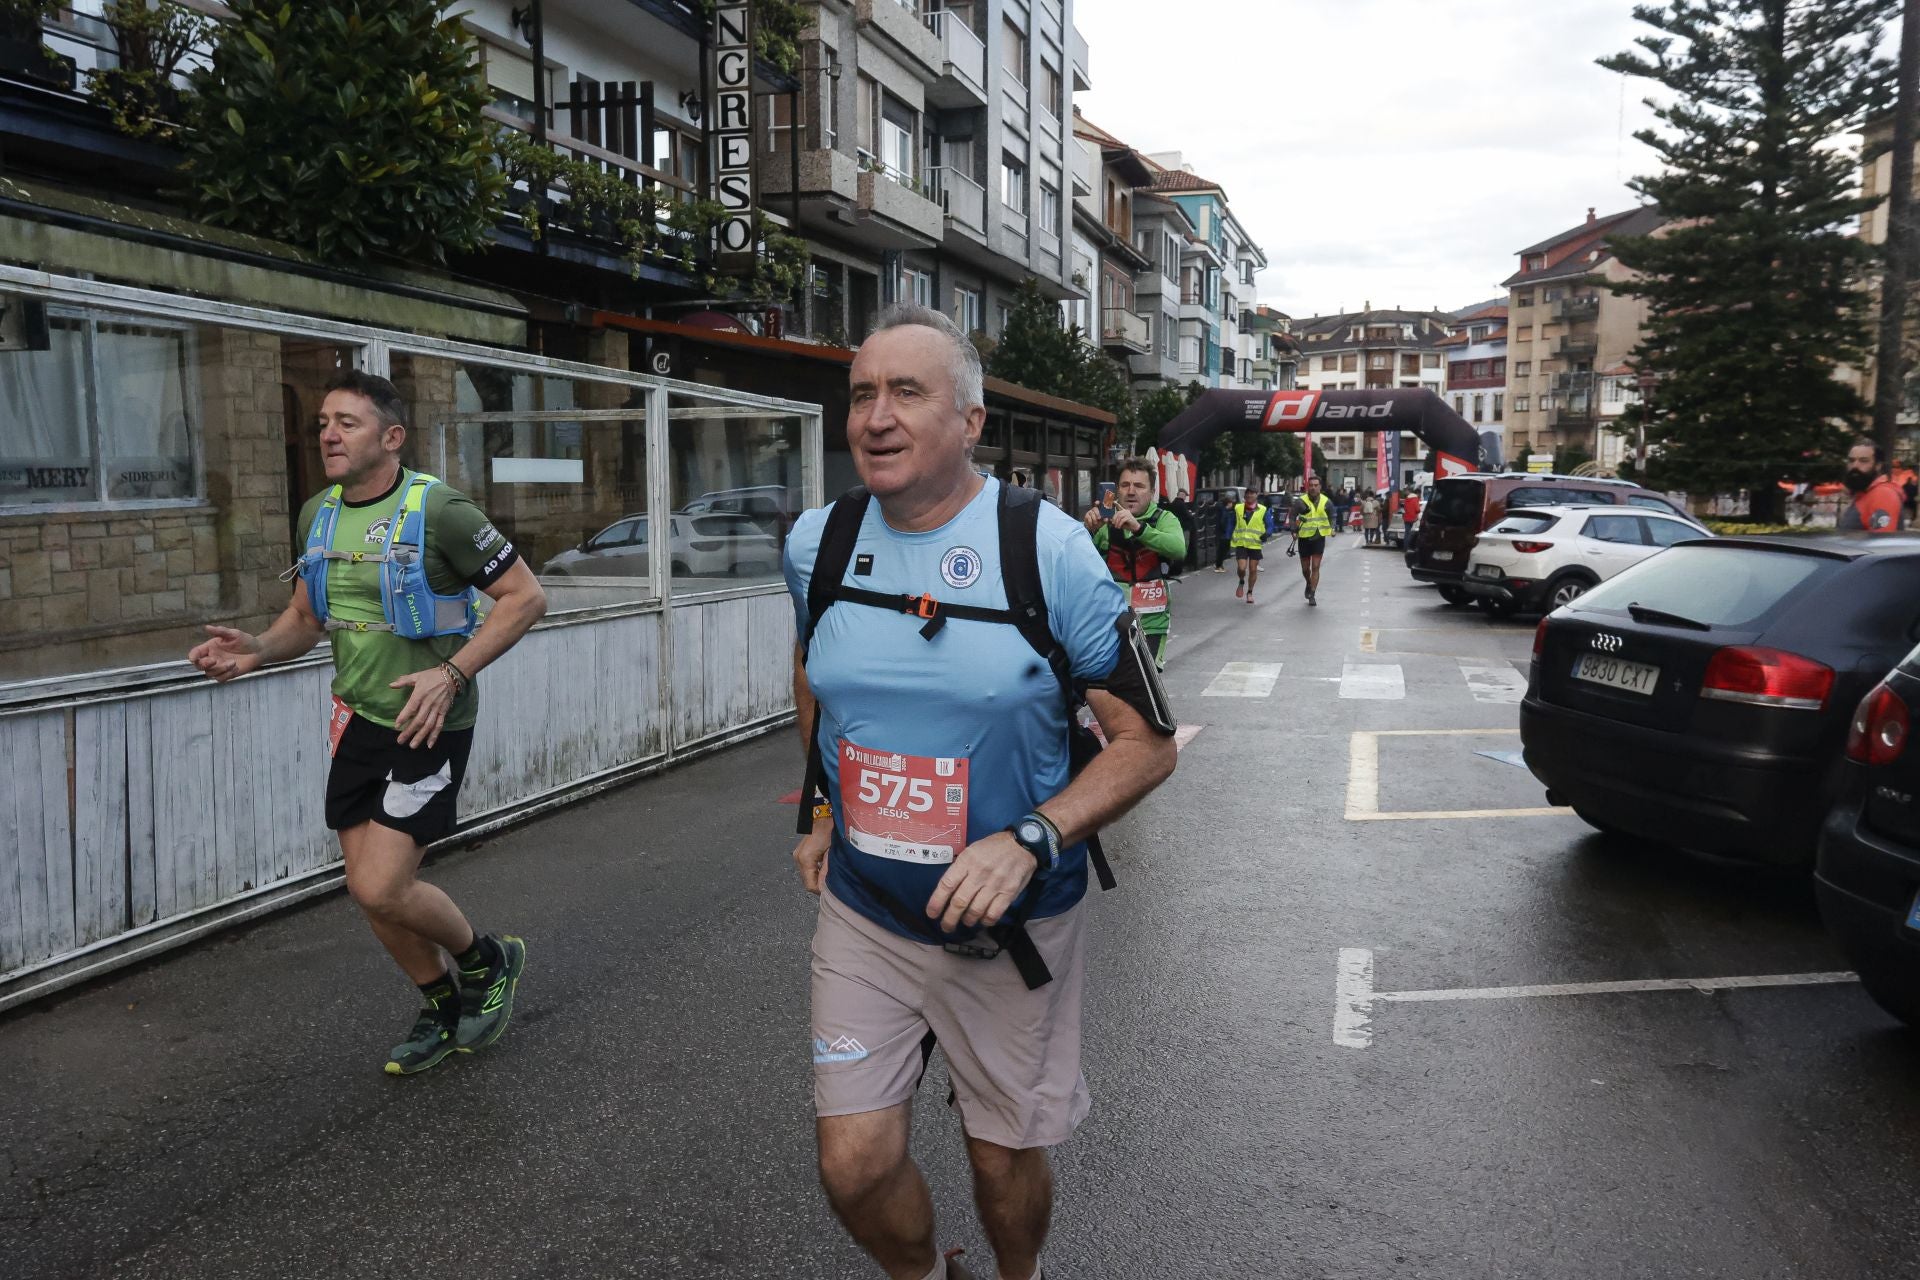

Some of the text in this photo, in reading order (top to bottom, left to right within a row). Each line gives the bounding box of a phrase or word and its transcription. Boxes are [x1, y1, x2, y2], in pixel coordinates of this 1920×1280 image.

[718, 0, 751, 251] NGRESO
[26, 467, 89, 488] MERY
[367, 536, 386, 545] MO
[484, 560, 498, 575] AD
[1140, 587, 1163, 600] 759
[1621, 664, 1653, 689] CXT
[858, 768, 934, 812] 575
[878, 806, 910, 820] JESÚS
